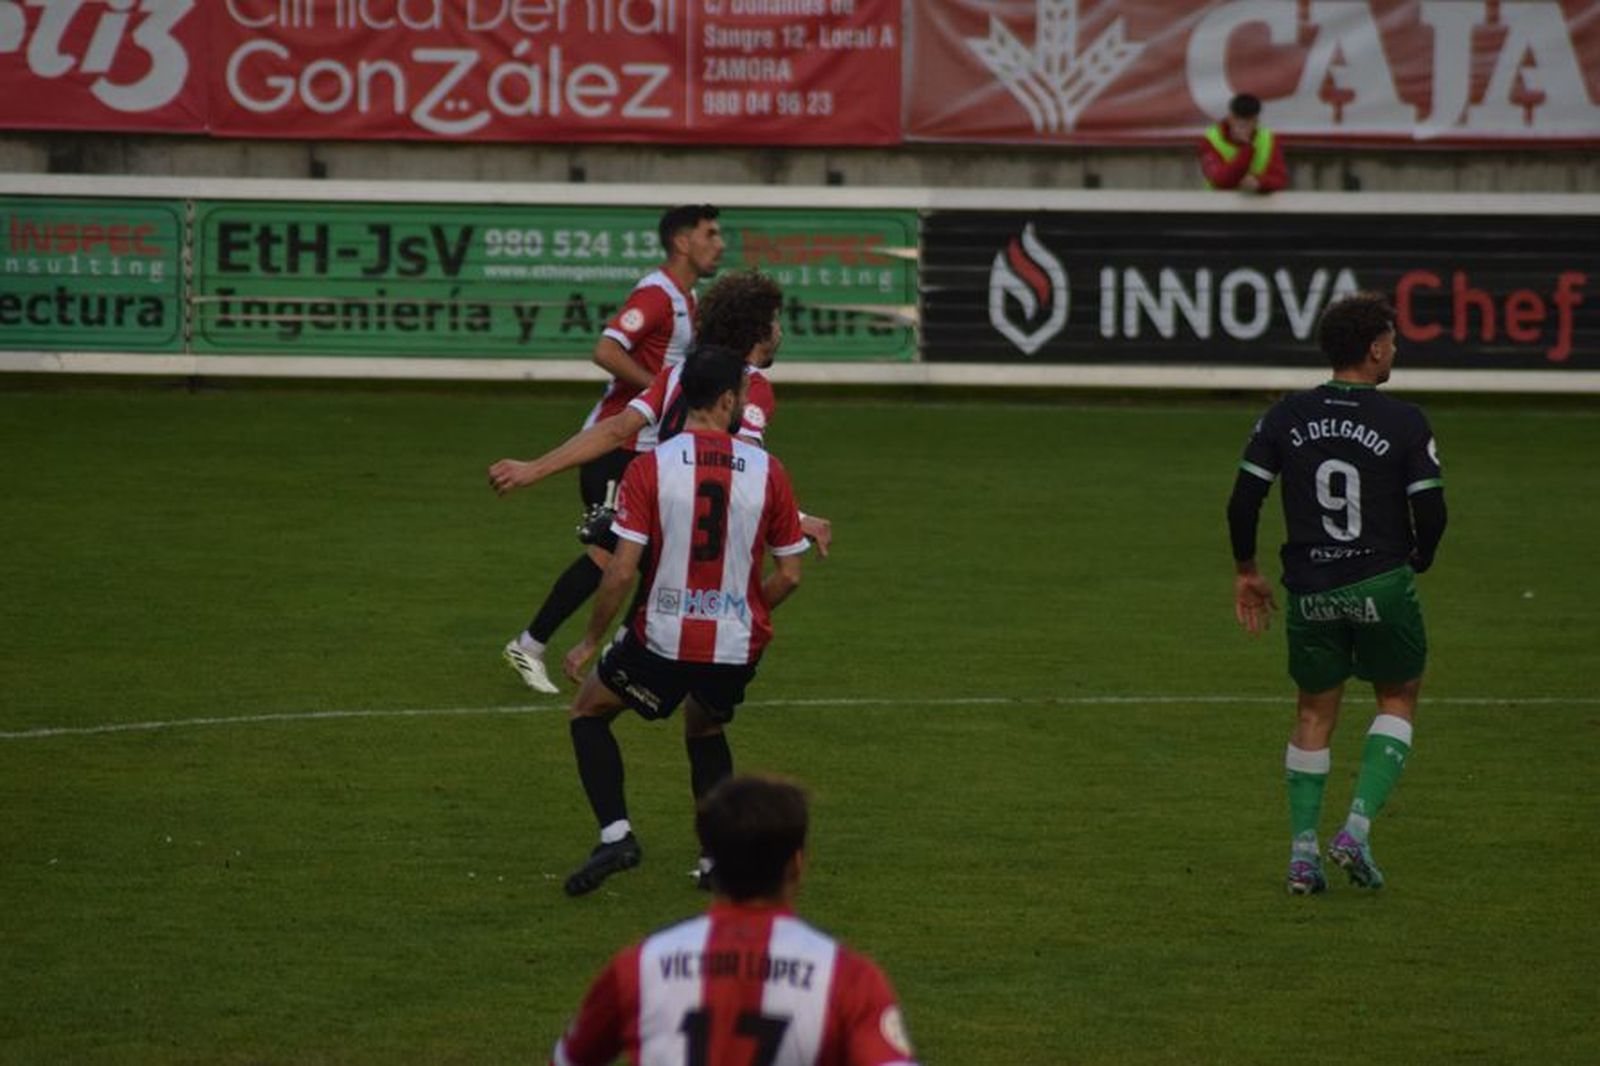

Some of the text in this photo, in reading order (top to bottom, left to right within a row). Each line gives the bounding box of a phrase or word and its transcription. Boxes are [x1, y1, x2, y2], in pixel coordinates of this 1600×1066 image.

[703, 25, 774, 51] Sangre
[819, 27, 875, 48] Local
[880, 26, 896, 48] A
[703, 57, 793, 81] ZAMORA
[1185, 0, 1600, 140] CAJA
[703, 90, 740, 115] 980
[745, 90, 771, 115] 04
[806, 91, 833, 115] 23
[216, 222, 475, 278] EtH-JsV
[484, 228, 666, 260] 980 524 13
[513, 303, 541, 342] y
[1395, 270, 1587, 361] Chef
[1308, 418, 1391, 457] DELGADO
[1315, 458, 1362, 541] 9
[693, 479, 725, 562] 3
[684, 588, 747, 617] HGM
[677, 1007, 793, 1066] 17
